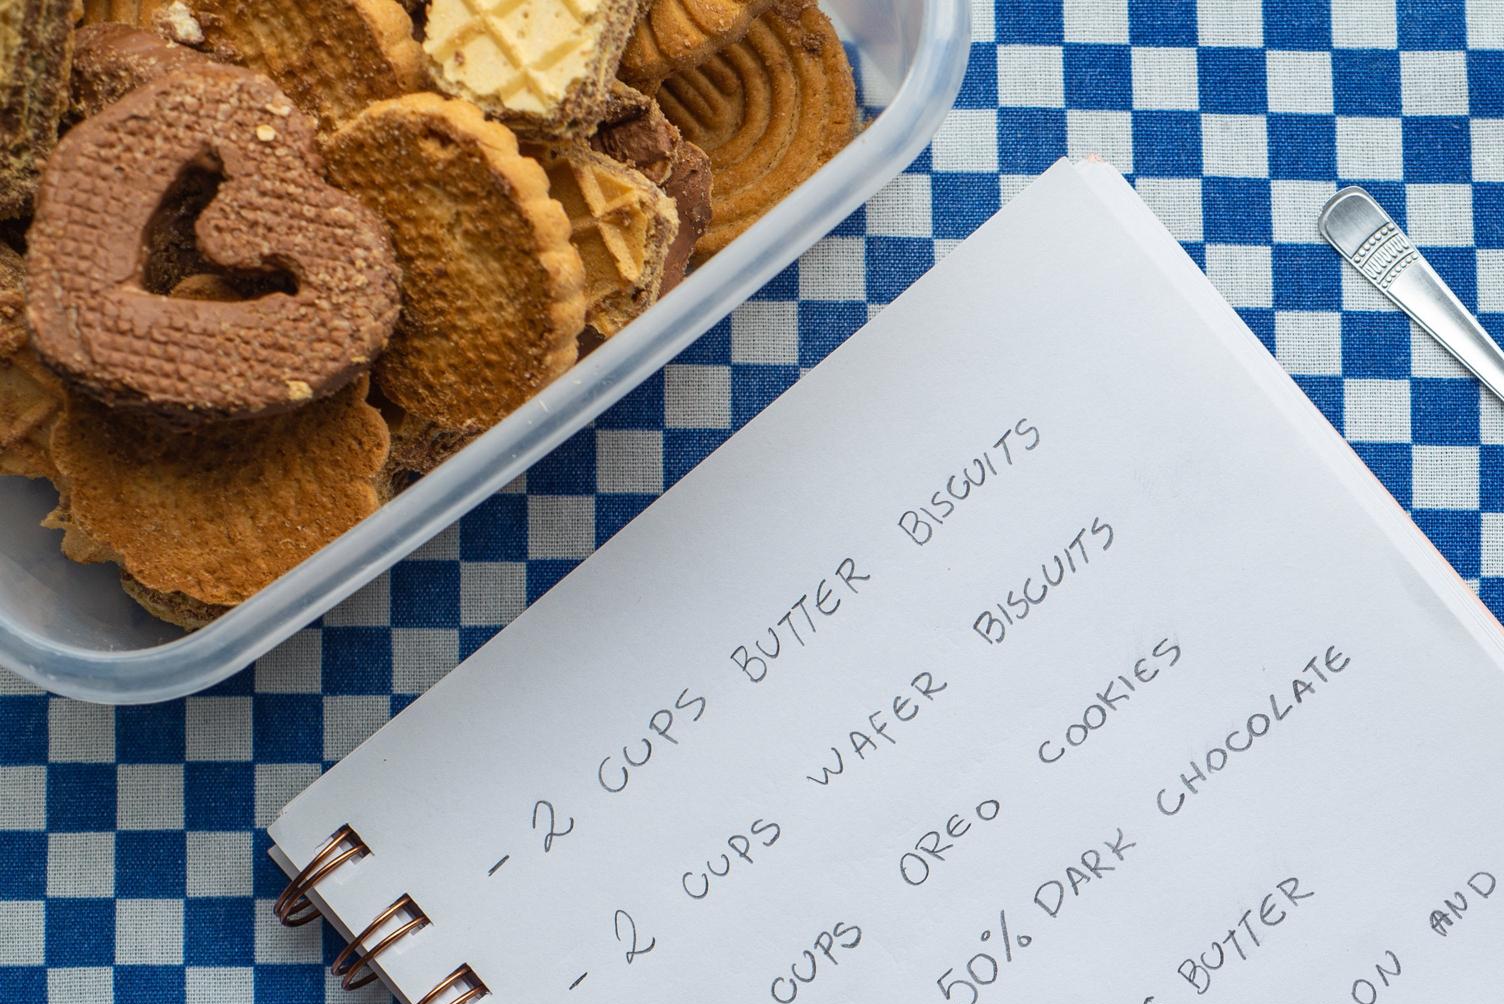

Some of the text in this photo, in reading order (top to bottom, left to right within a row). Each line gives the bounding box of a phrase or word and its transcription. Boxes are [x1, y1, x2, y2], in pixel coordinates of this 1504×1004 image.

[532, 800, 574, 853] 2
[598, 688, 706, 793] CUPS
[730, 558, 871, 683] BUTTER
[897, 418, 1040, 546] BISCUITS
[614, 908, 655, 965] 2
[682, 819, 780, 899] CUPS
[806, 672, 947, 785] WAFER
[973, 517, 1113, 645] BISCUITS
[1034, 828, 1136, 918] DARK
[1157, 645, 1351, 816] CHOCOLATE
[771, 922, 862, 1004] CUPS
[900, 799, 1000, 886] OREO
[1038, 638, 1181, 763] COOKIES
[1177, 877, 1315, 995] BUTTER
[1429, 872, 1496, 937] AND
